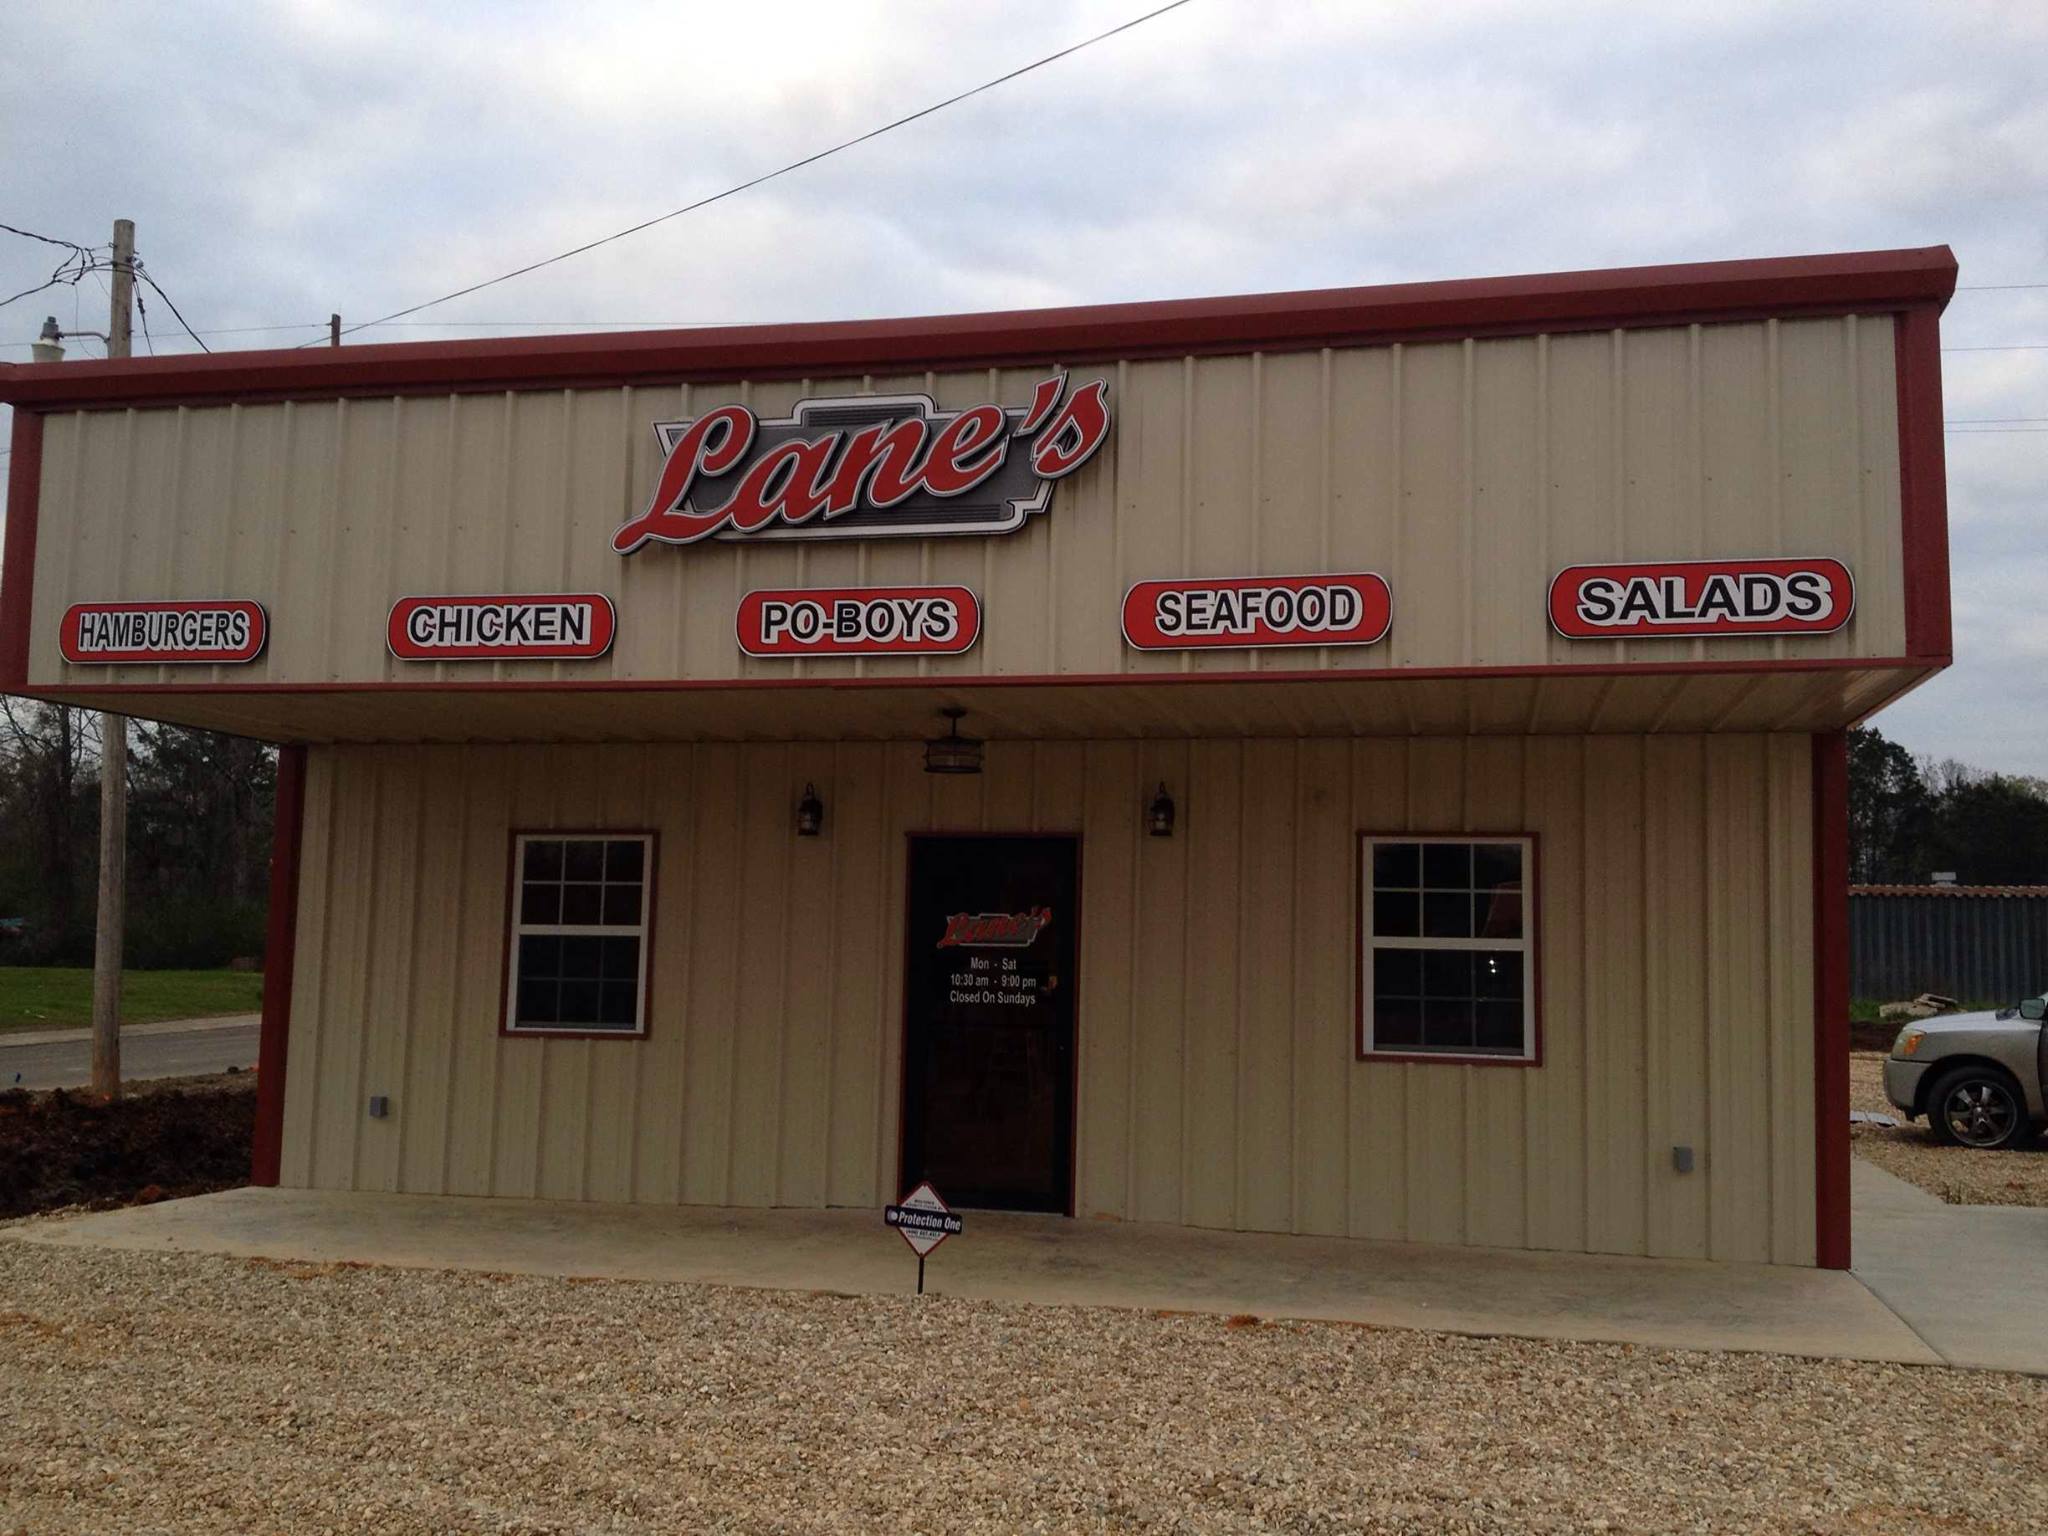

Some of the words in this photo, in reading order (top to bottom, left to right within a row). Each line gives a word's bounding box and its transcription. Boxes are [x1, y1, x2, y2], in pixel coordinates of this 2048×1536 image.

[611, 369, 1111, 556] Lane's
[1157, 587, 1360, 634] SEAFOOD
[1578, 572, 1829, 624] SALADS
[78, 611, 250, 650] HAMBURGERS
[407, 604, 589, 646] CHICKEN
[762, 600, 956, 642] PO-BOYS
[950, 974, 974, 986] 10:30
[975, 977, 989, 986] am
[1001, 975, 1020, 987] 9:00
[1022, 977, 1037, 990] pm
[970, 957, 990, 970] Mon
[1002, 957, 1017, 970] Sat
[950, 990, 981, 1003] Closed
[982, 991, 995, 1003] On
[997, 991, 1036, 1007] Sundays
[898, 1211, 943, 1228] Protection
[943, 1217, 961, 1231] One
